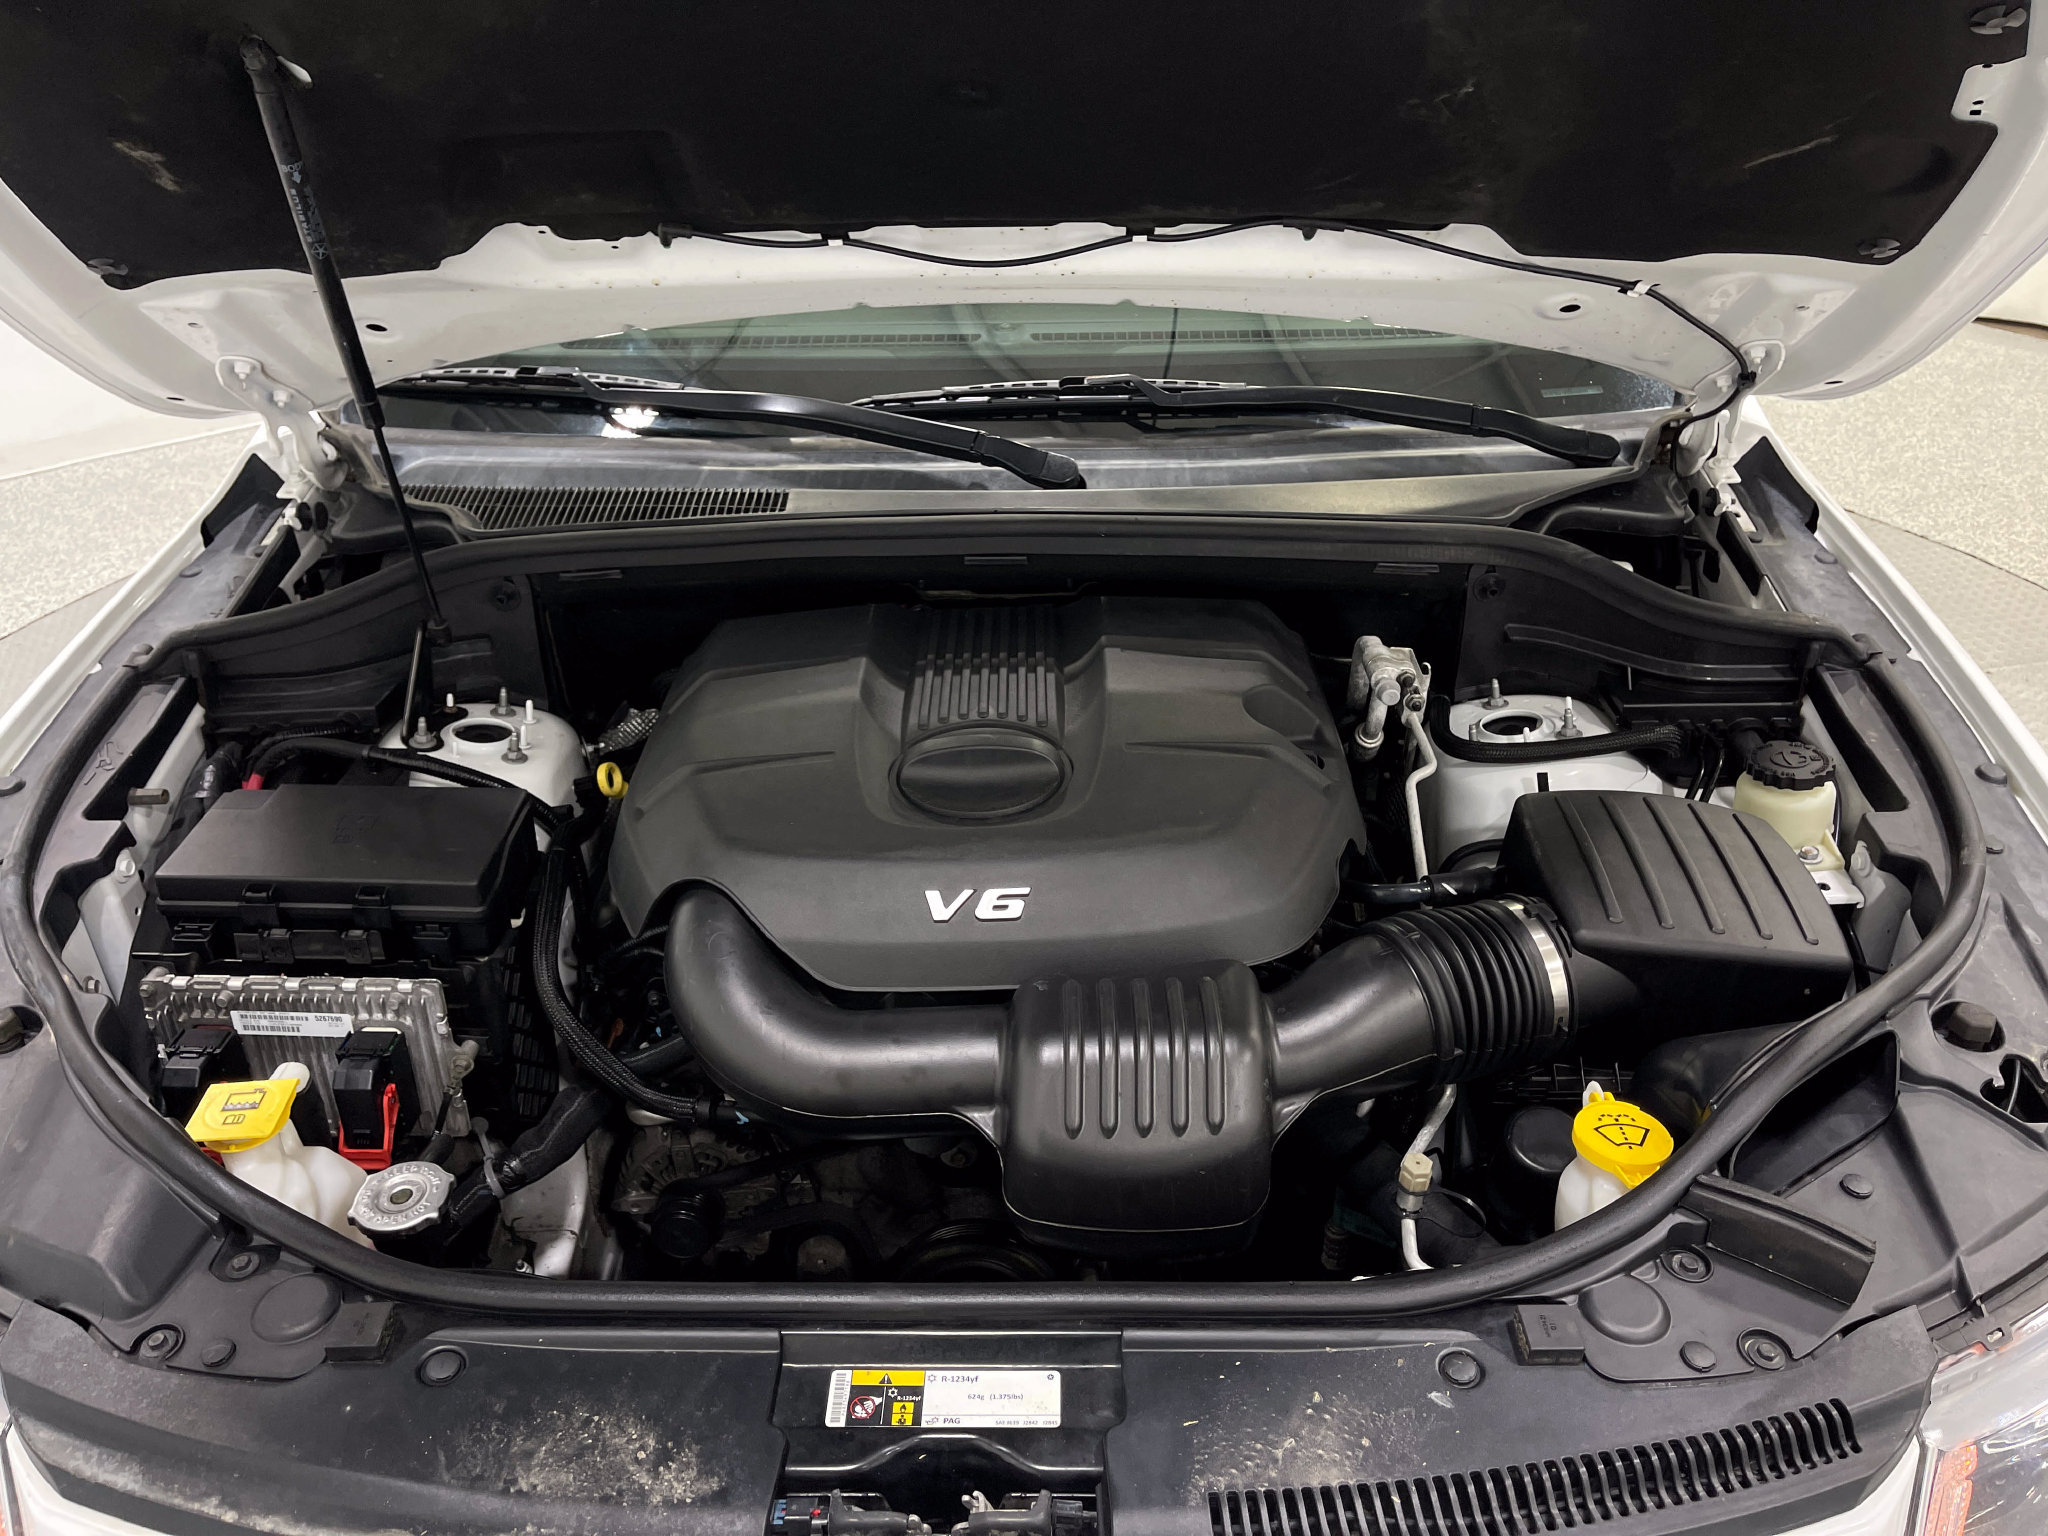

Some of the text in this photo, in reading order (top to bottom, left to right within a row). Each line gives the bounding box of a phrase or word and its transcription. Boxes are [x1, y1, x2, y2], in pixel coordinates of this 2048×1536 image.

[924, 887, 1032, 923] V6
[941, 1375, 979, 1384] R-1234yf
[967, 1393, 985, 1401] 624g
